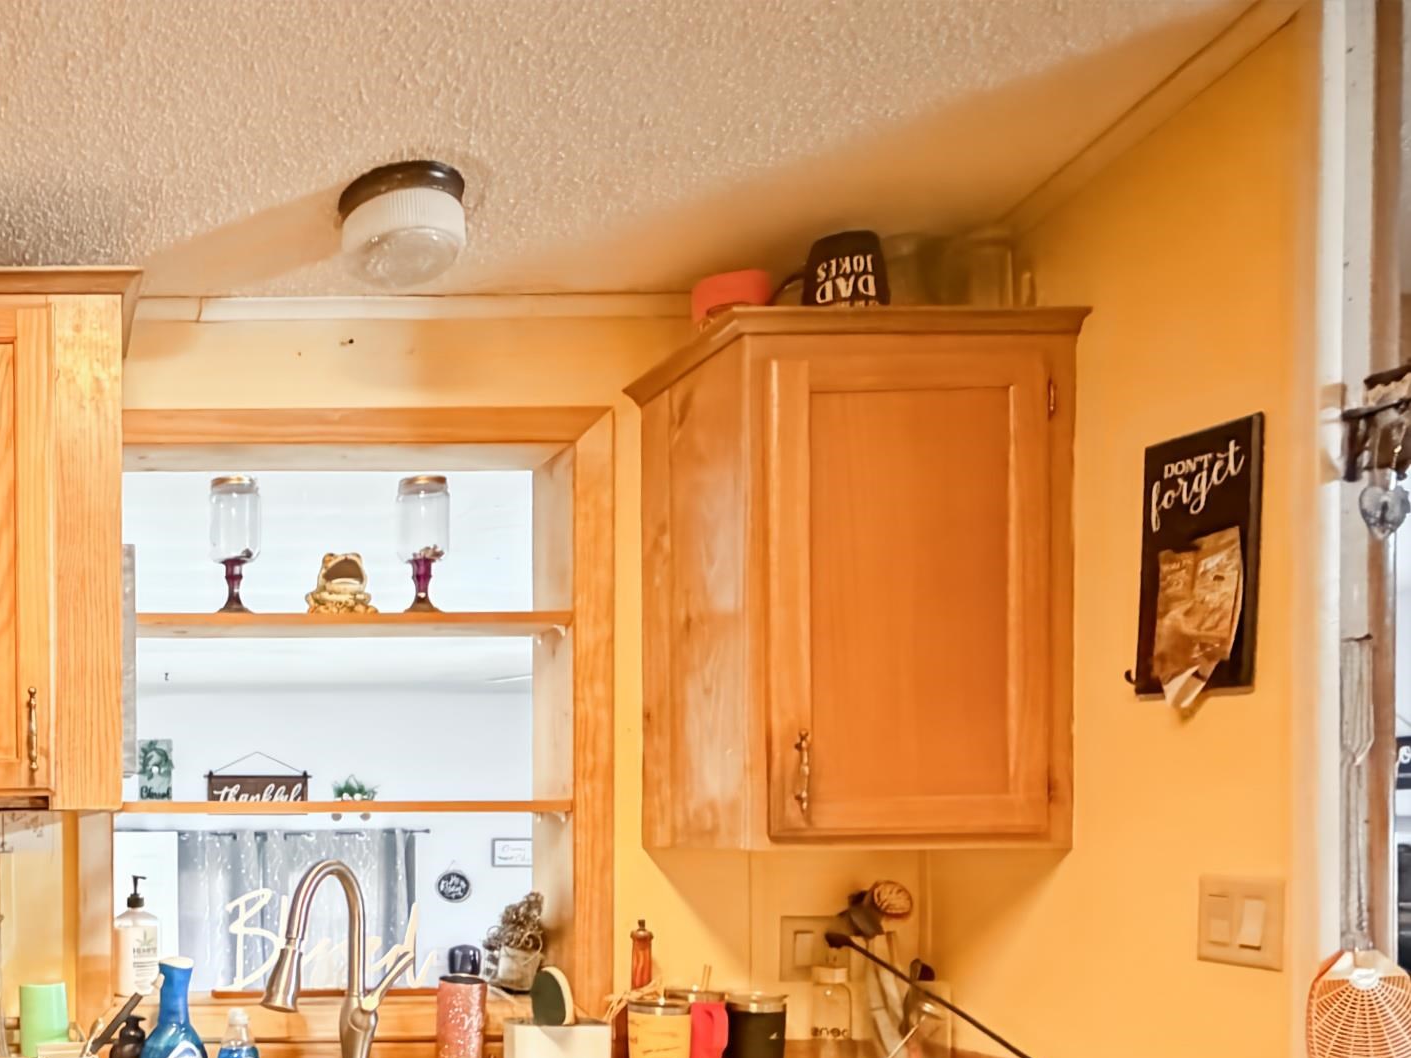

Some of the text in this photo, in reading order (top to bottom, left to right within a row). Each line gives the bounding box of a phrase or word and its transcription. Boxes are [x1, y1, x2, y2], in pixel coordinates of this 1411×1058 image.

[817, 254, 873, 283] JOKES
[816, 274, 876, 304] DAD
[1164, 452, 1213, 480] DON'T
[1151, 439, 1245, 533] forget
